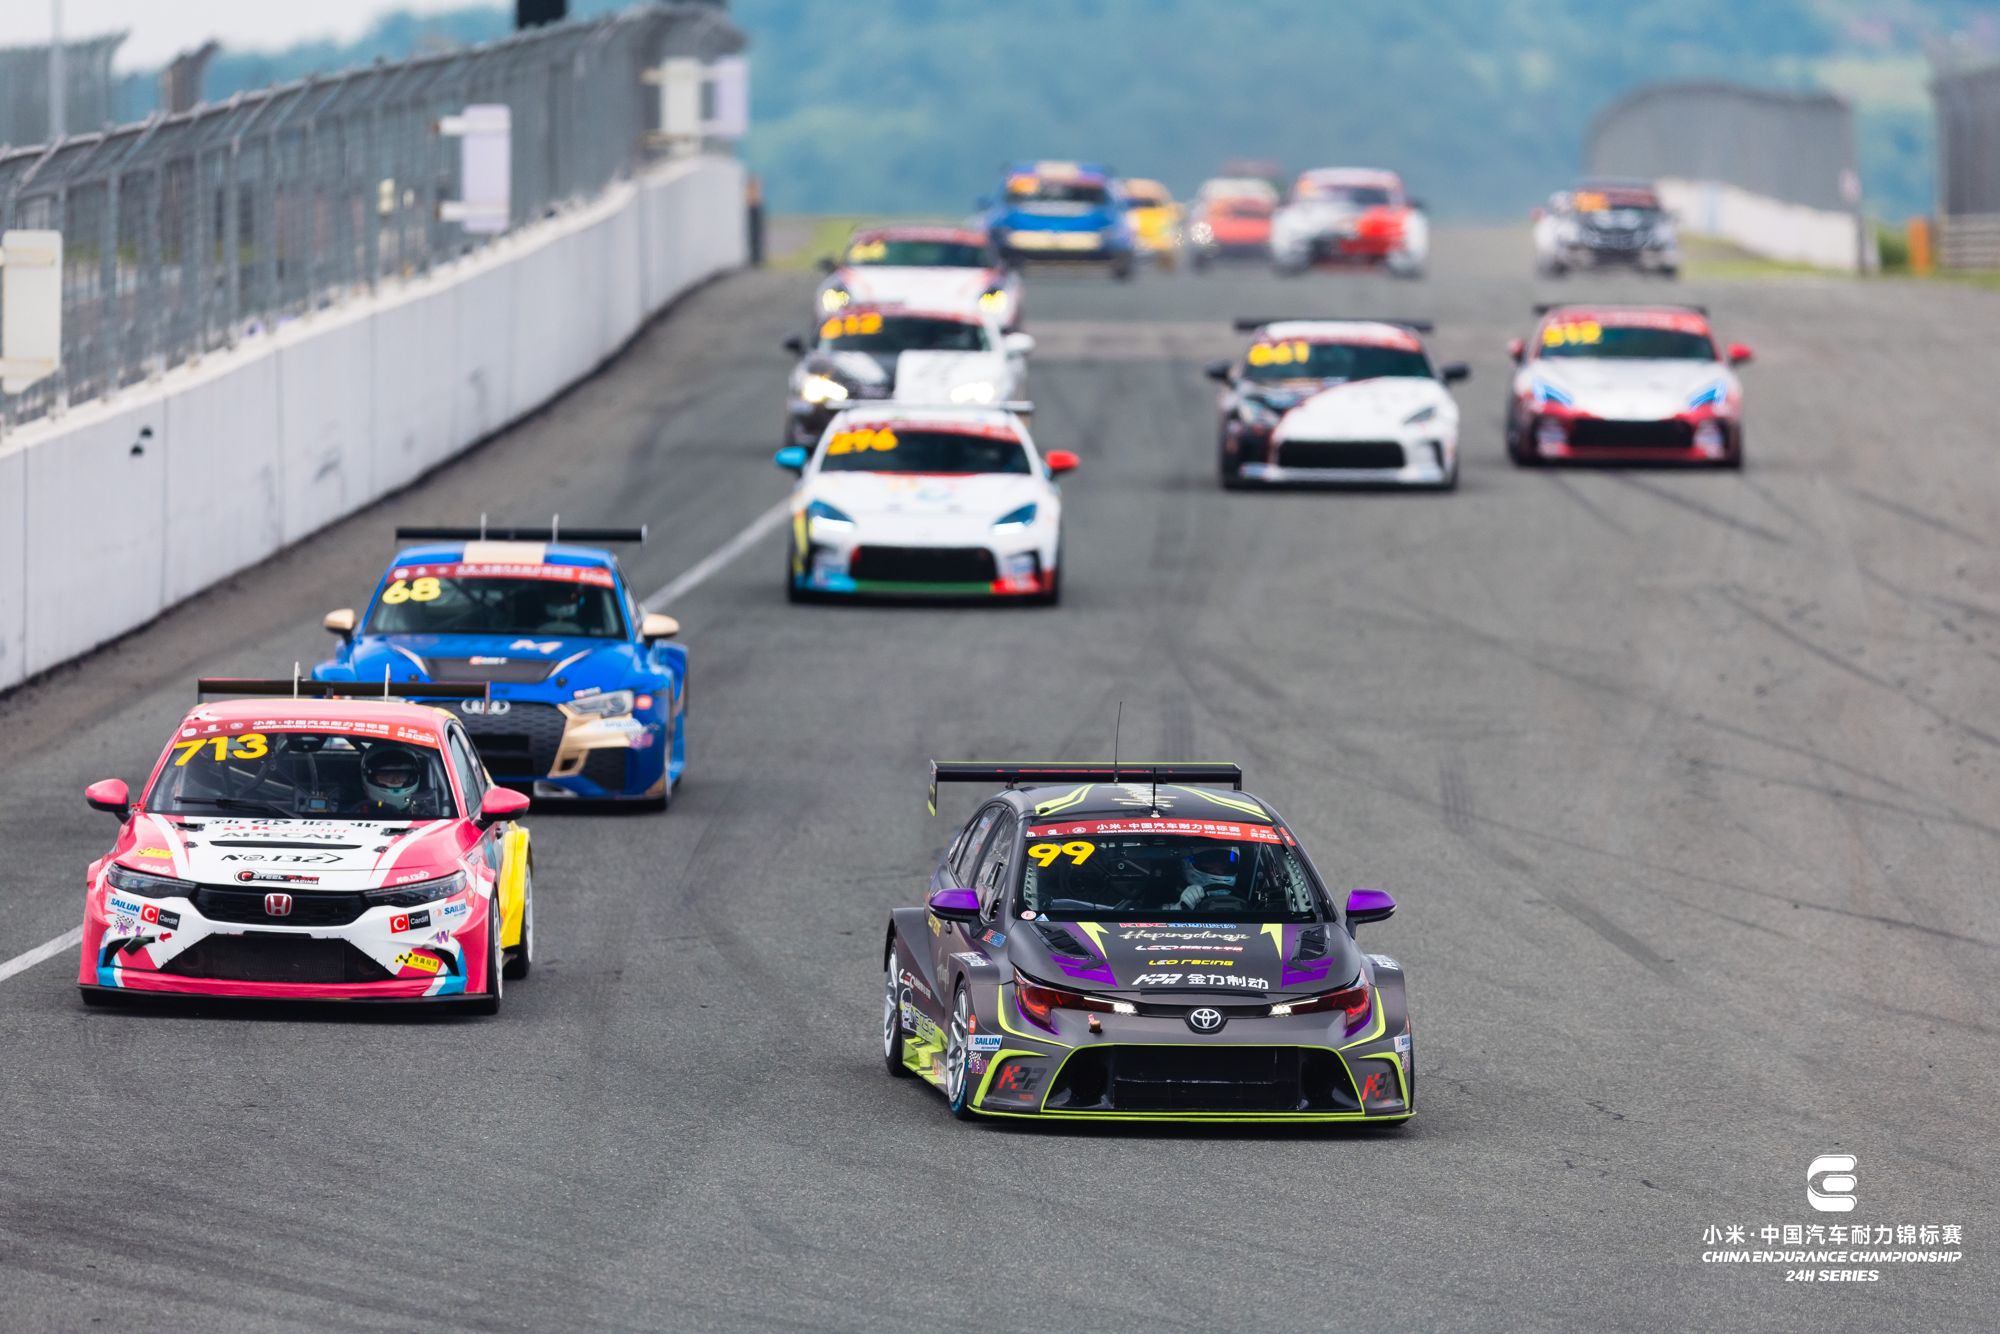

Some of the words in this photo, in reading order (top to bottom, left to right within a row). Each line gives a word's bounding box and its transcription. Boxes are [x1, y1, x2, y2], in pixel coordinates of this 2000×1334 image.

[382, 577, 442, 605] 68
[174, 733, 269, 767] 713
[1028, 841, 1096, 868] 99
[111, 898, 141, 913] SAILUN
[1187, 973, 1270, 989] 金力制动
[974, 1037, 1001, 1046] SAILUN
